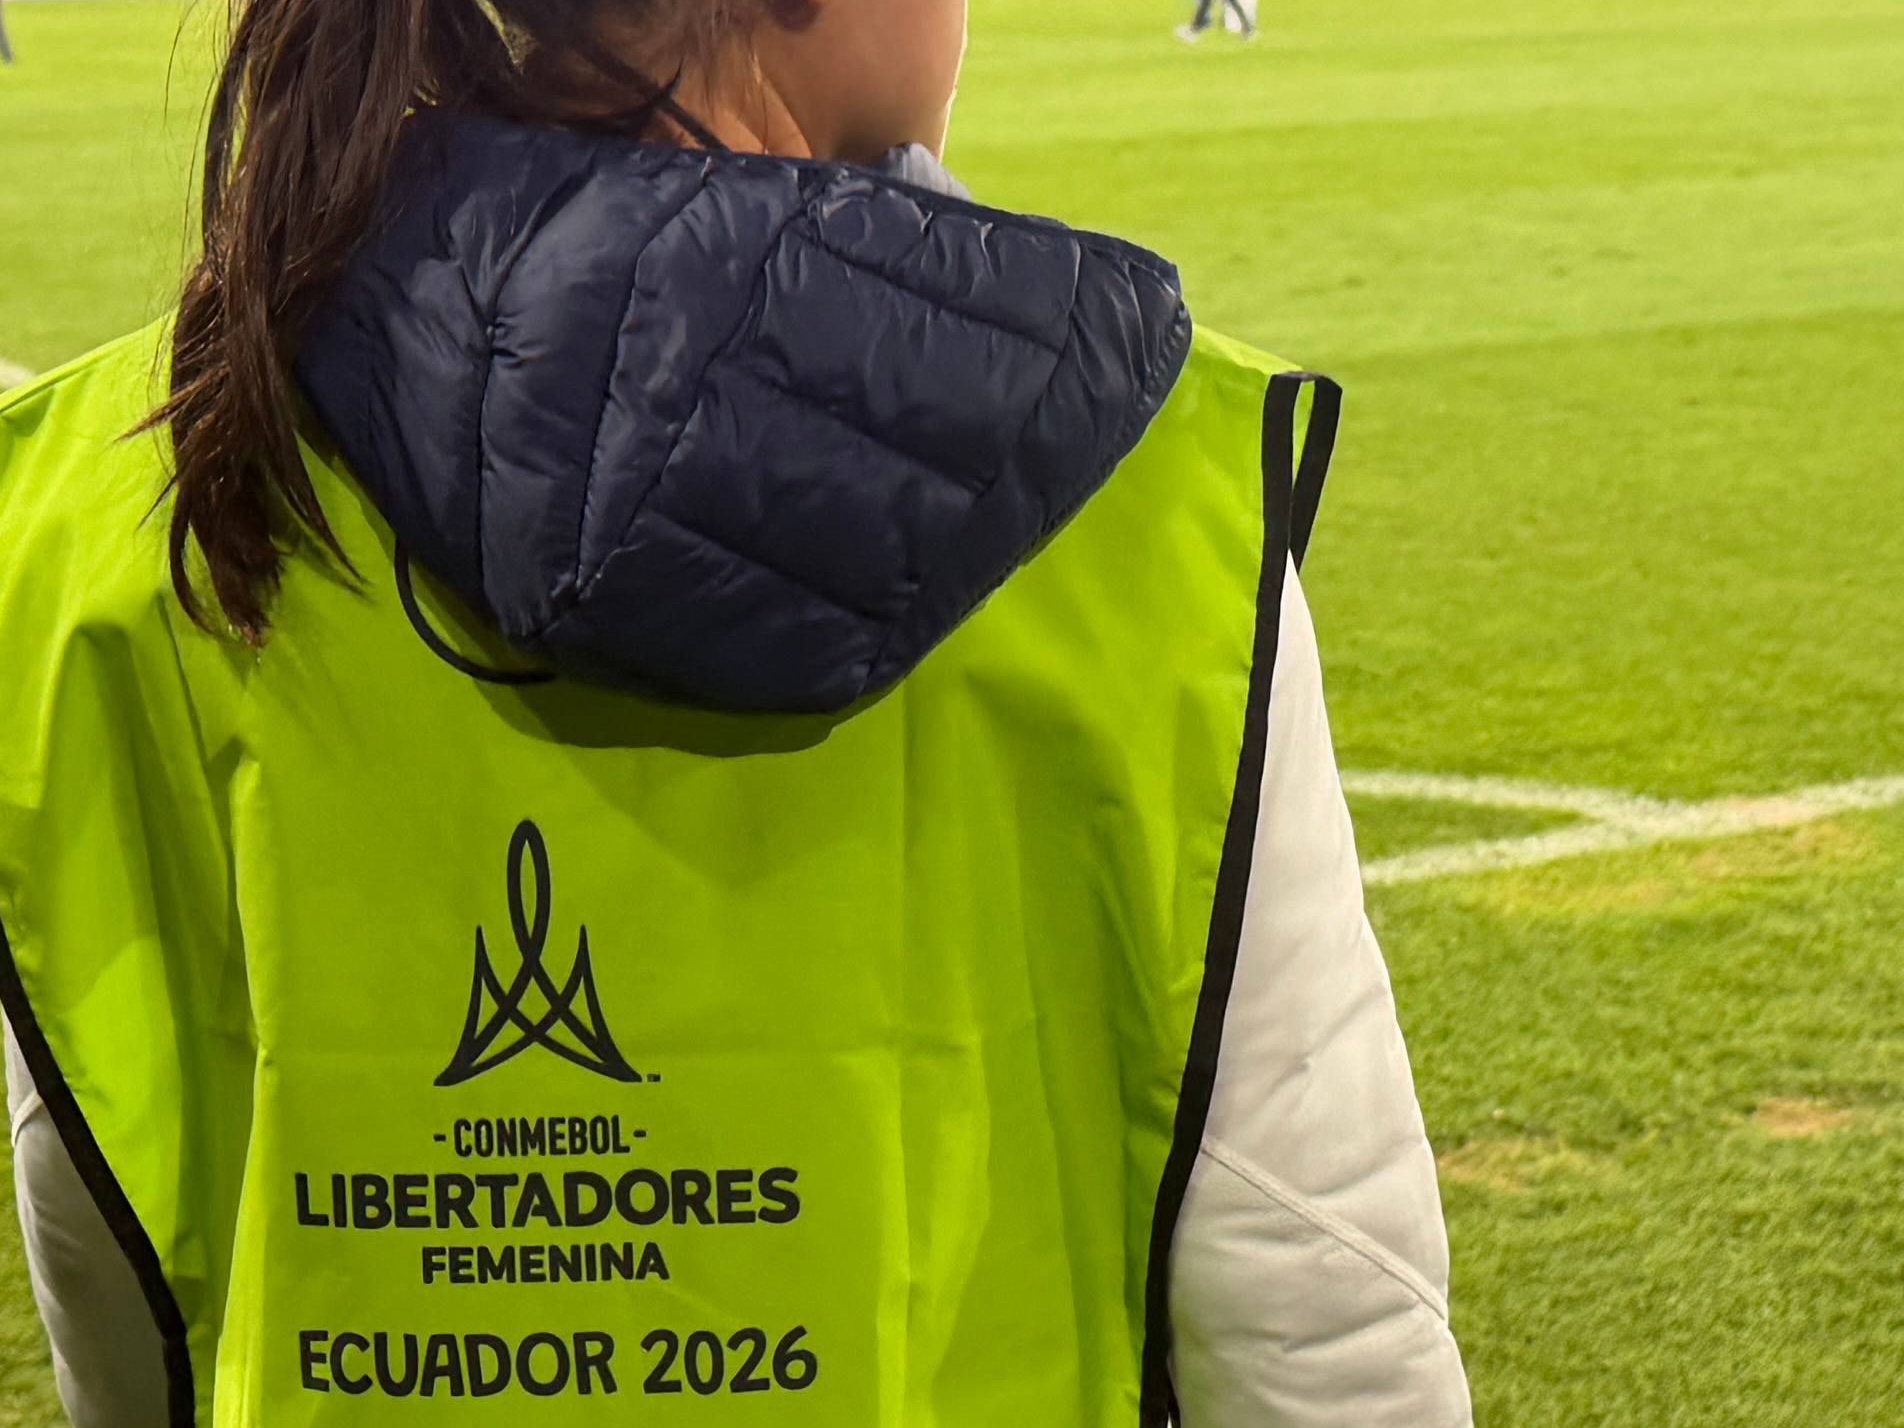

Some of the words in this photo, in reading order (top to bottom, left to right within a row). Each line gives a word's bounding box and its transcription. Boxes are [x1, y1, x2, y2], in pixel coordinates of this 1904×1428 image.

[294, 1167, 800, 1230] LIBERTADORES
[422, 1242, 670, 1285] FEMENINA
[299, 1330, 618, 1398] ECUADOR
[641, 1325, 818, 1396] 2026
